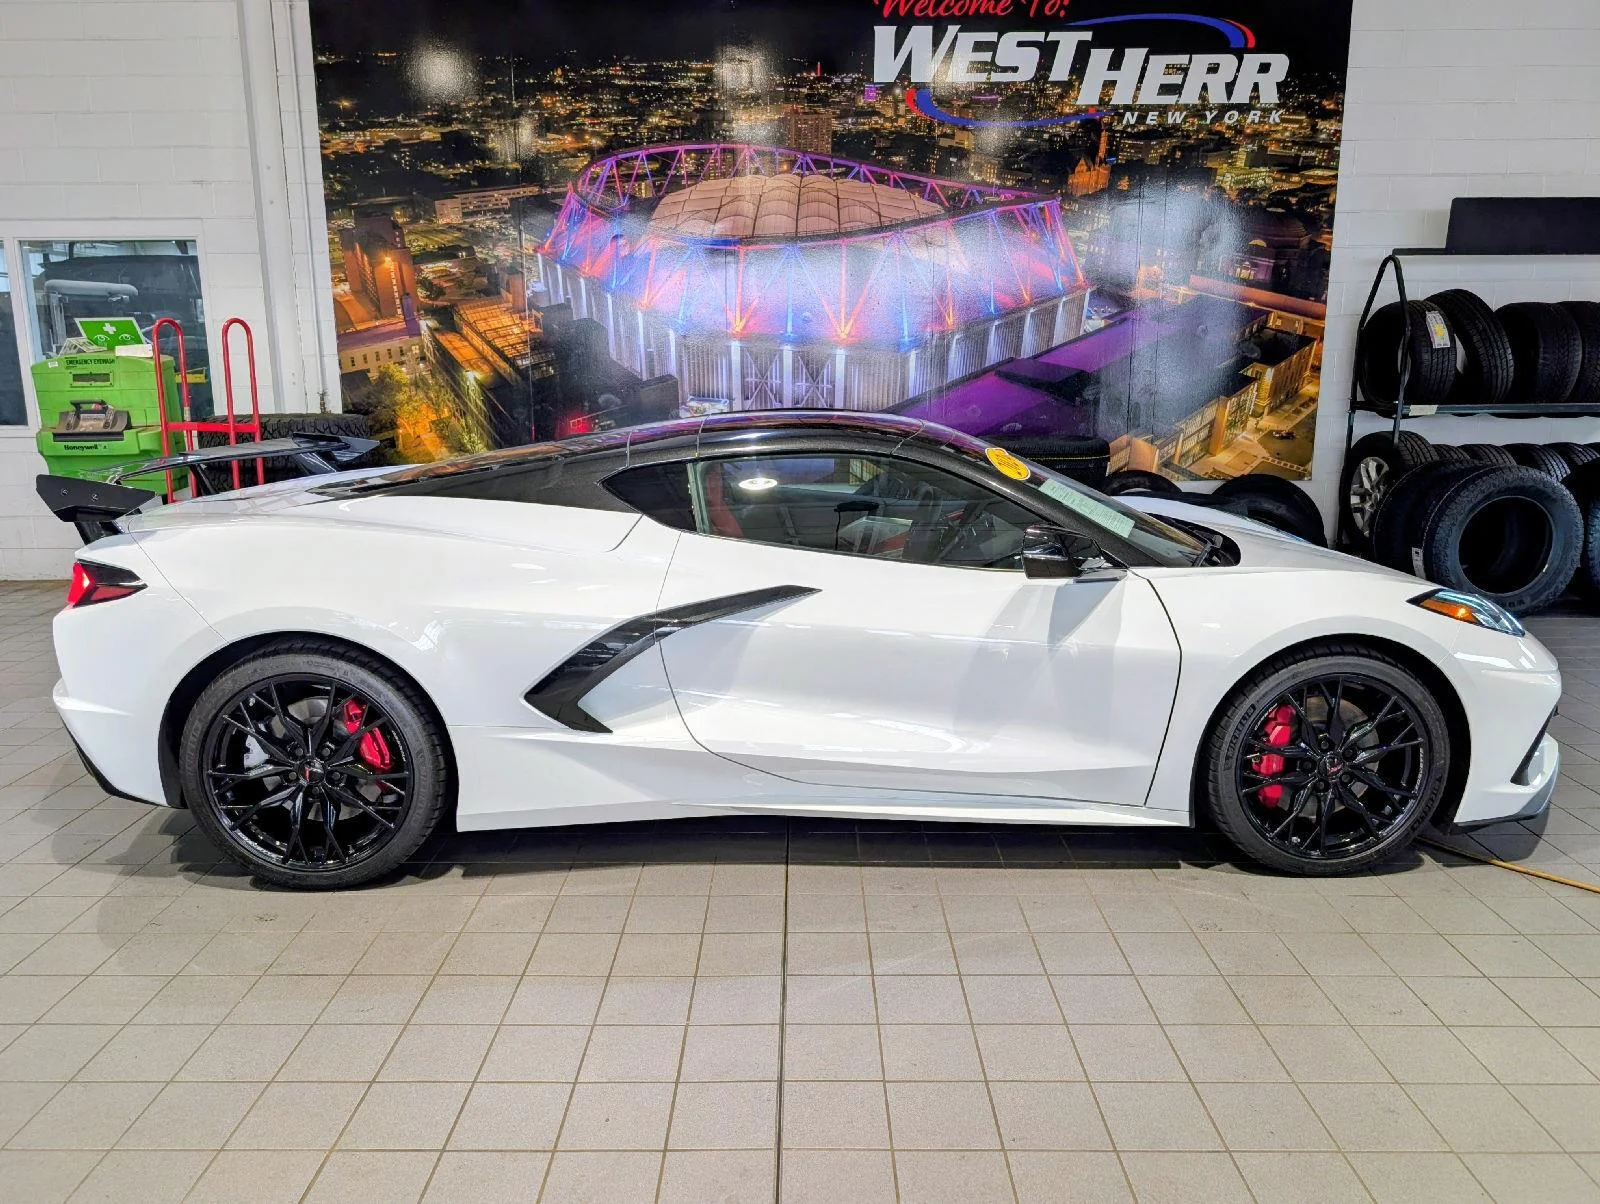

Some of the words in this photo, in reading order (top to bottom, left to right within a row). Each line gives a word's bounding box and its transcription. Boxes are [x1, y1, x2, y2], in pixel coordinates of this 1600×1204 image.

[874, 0, 1014, 18] Welcome
[873, 25, 1093, 84] WEST
[1073, 48, 1290, 105] HERR
[1122, 111, 1187, 125] NEW
[1203, 110, 1285, 125] YORK
